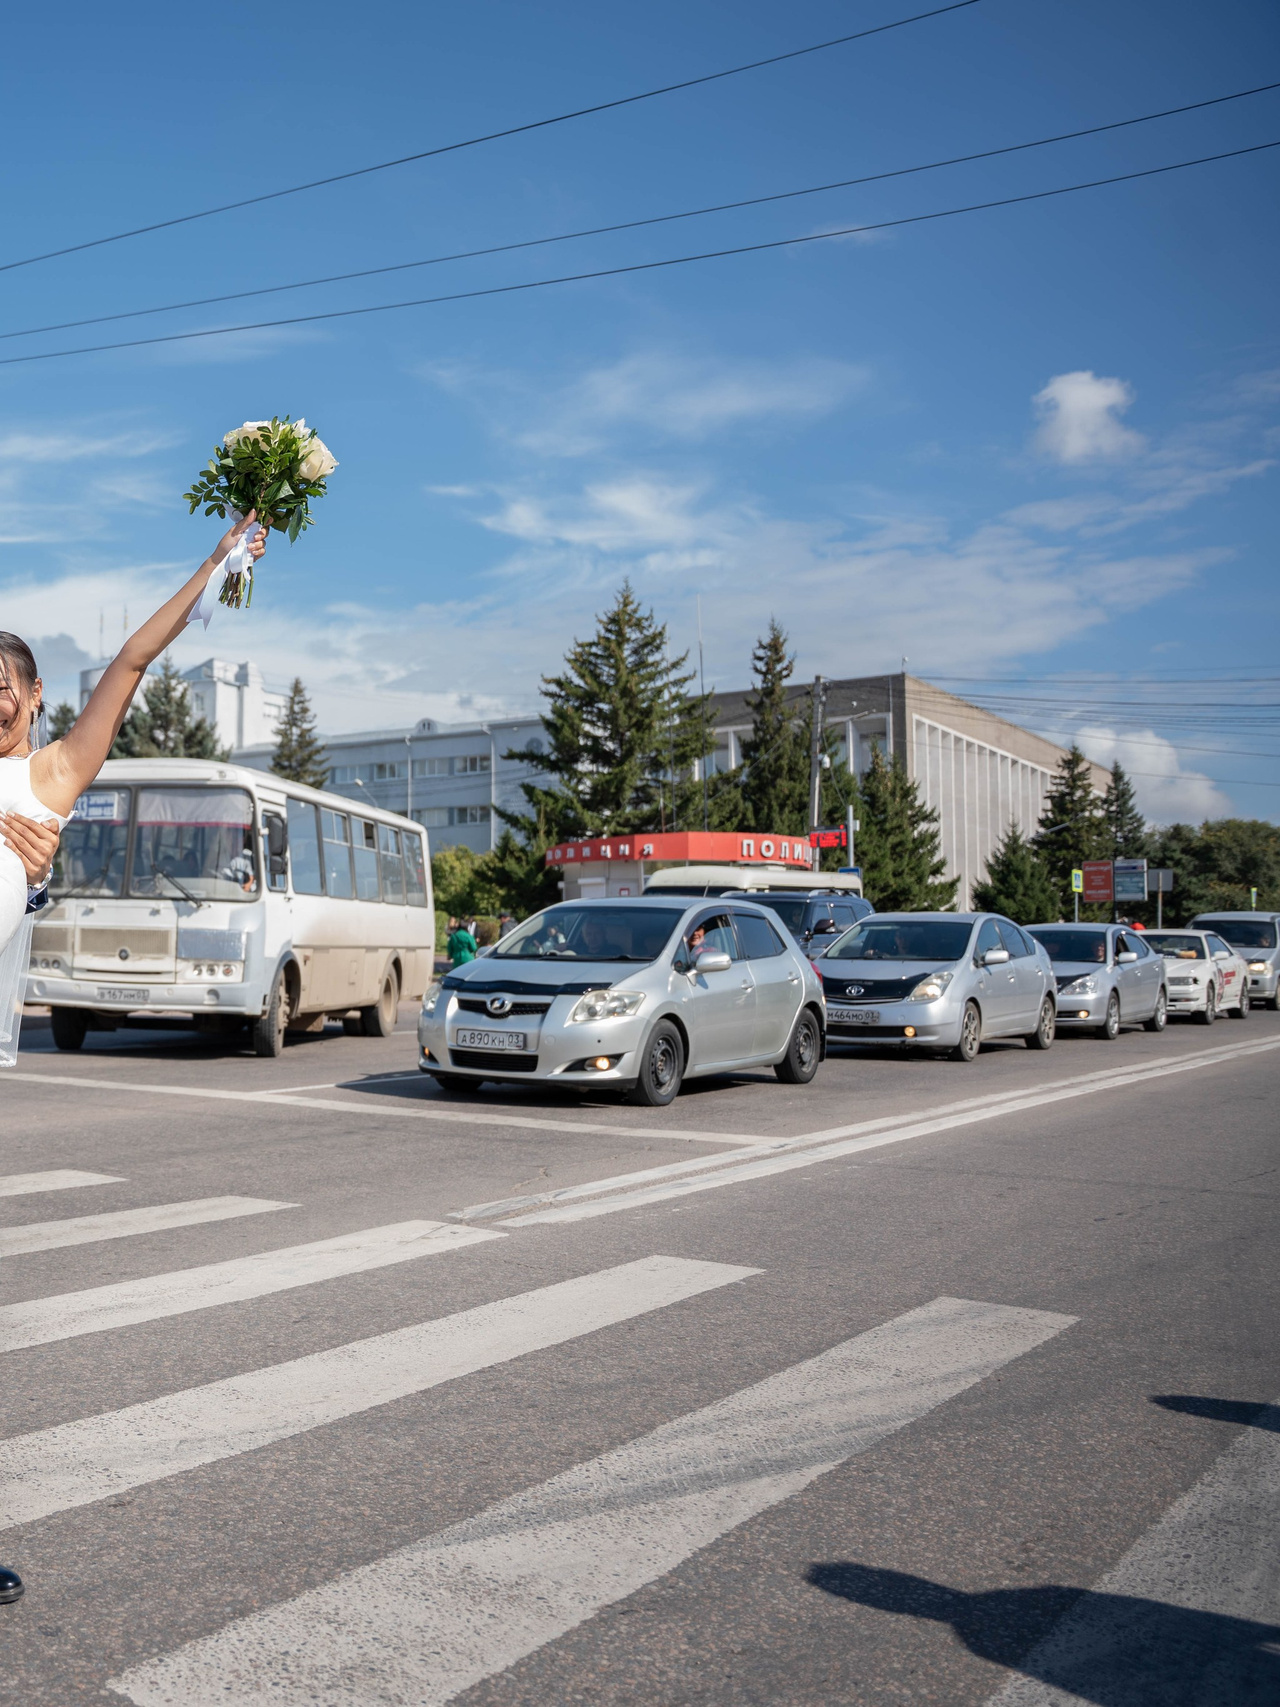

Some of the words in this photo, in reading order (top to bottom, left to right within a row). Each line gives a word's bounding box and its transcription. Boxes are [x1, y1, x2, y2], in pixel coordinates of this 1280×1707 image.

[546, 843, 654, 861] ПОЛИЦИЯ
[461, 1032, 505, 1047] А890КН
[507, 1033, 520, 1045] 03
